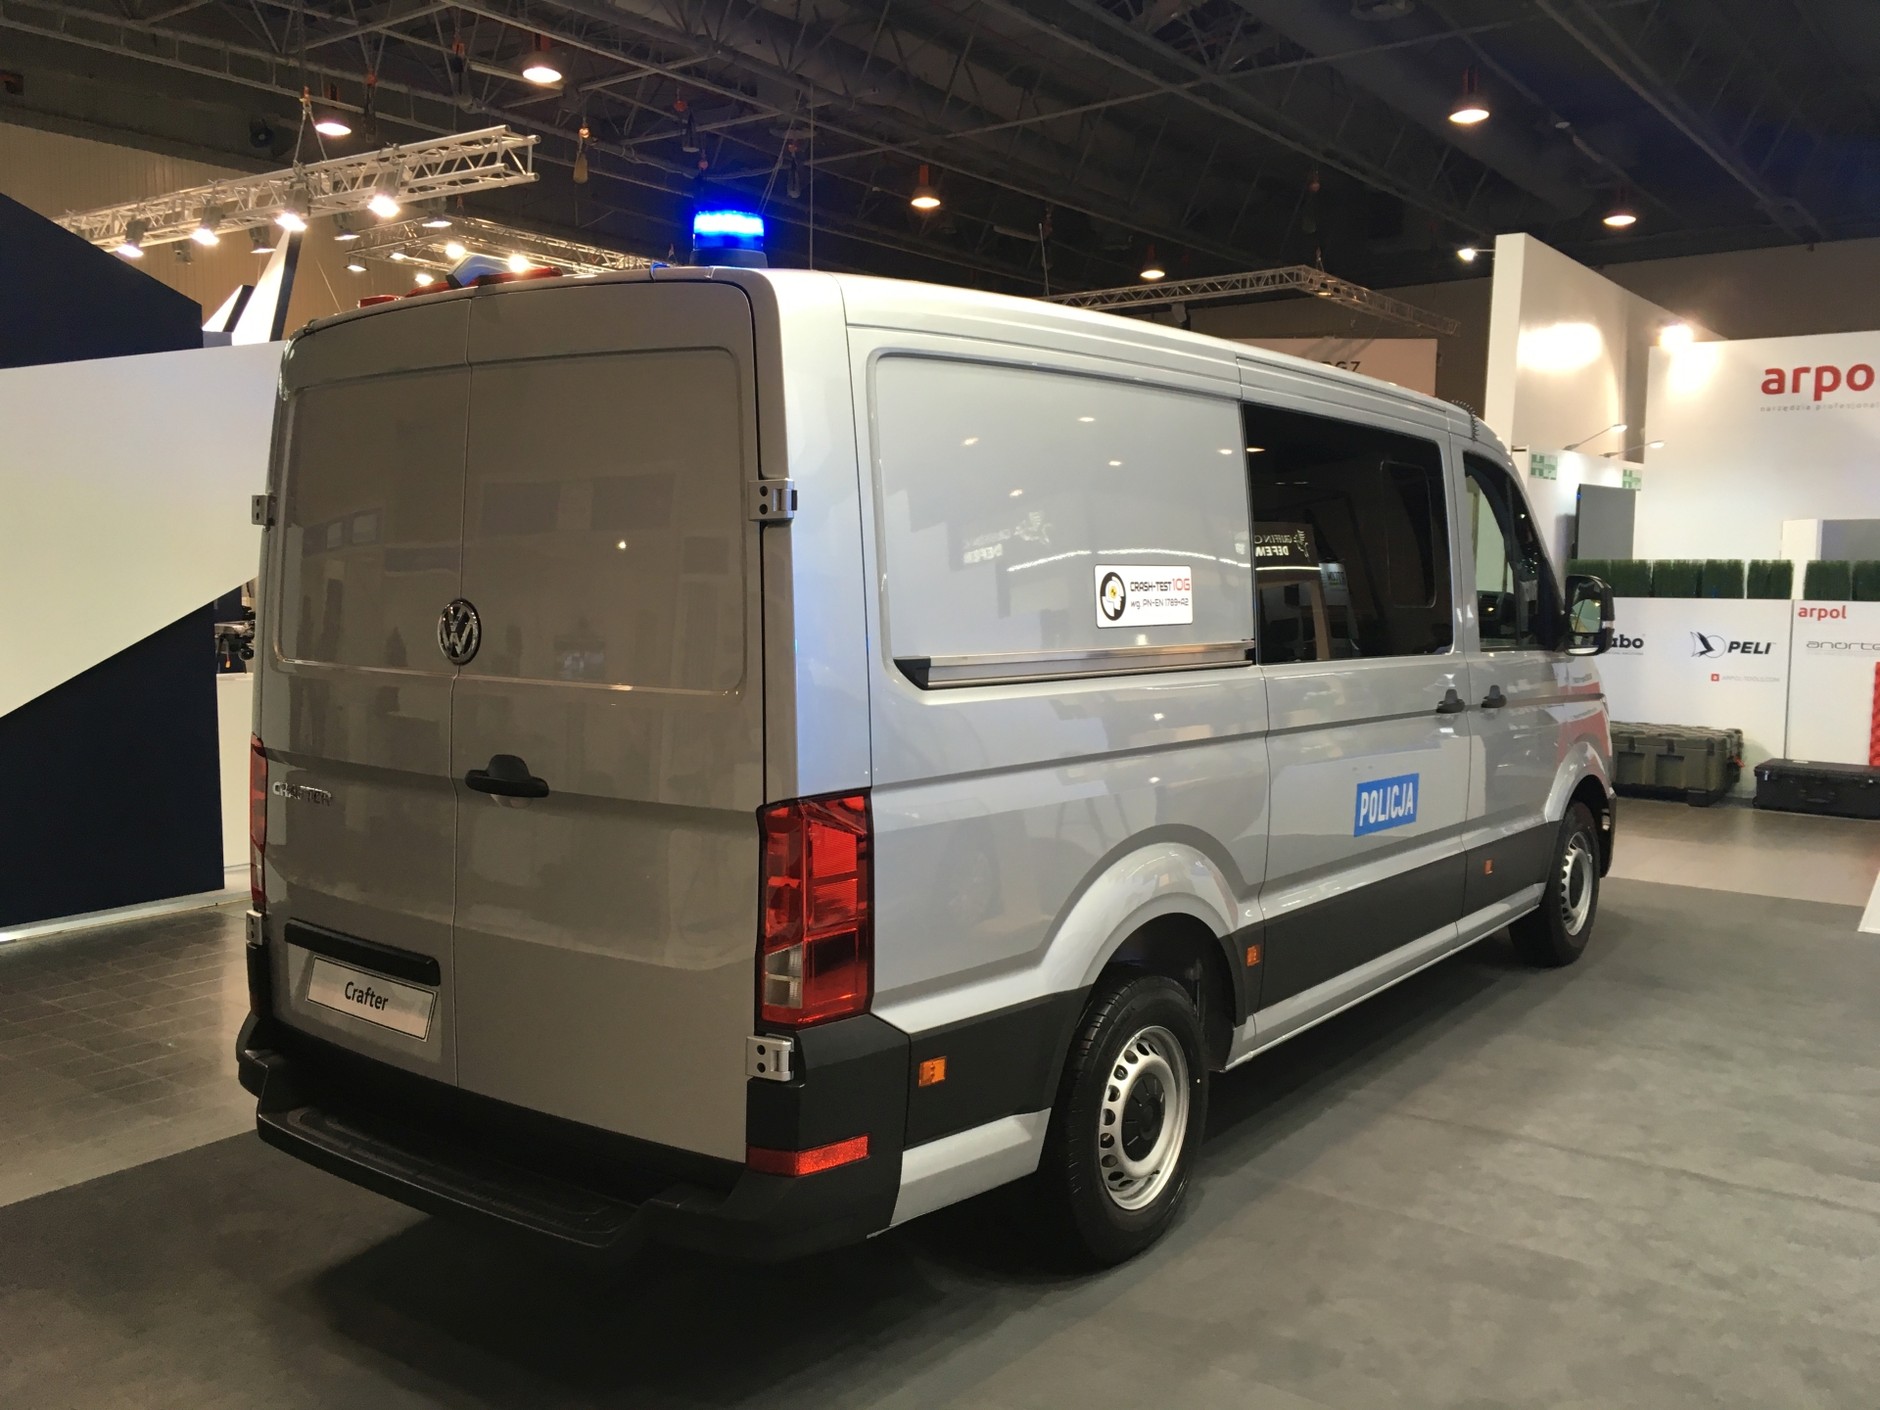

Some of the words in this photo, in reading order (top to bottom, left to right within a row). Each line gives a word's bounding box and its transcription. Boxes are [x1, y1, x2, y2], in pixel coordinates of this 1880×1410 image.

[1761, 363, 1875, 401] arpo
[1798, 605, 1847, 621] arpol
[1727, 641, 1771, 654] PELI
[1359, 782, 1414, 827] POLICJA
[344, 981, 389, 1011] Crafter
